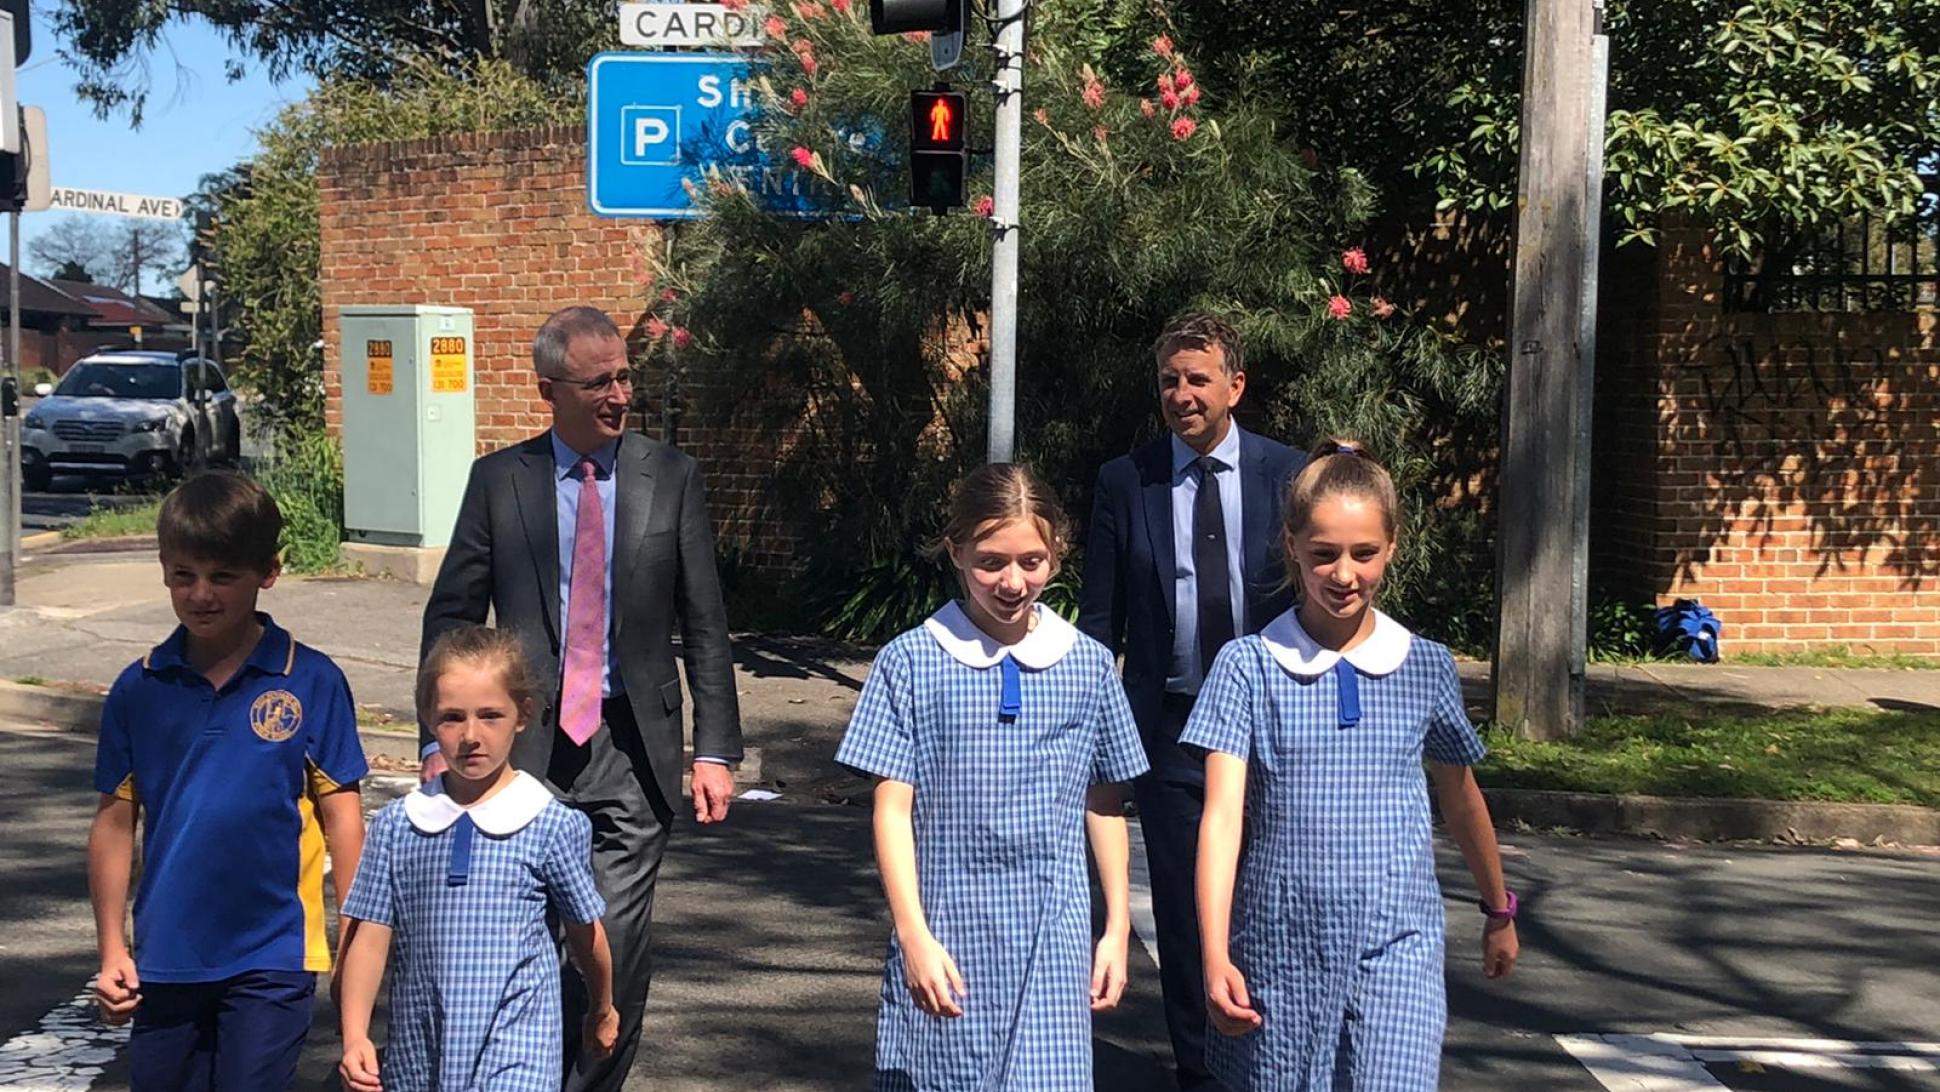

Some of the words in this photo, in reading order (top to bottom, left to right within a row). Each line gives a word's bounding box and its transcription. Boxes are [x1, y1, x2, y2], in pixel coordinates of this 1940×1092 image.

[635, 11, 758, 38] CARDI
[634, 118, 669, 156] P
[51, 189, 129, 213] ARDINAL
[137, 198, 172, 217] AVE
[432, 338, 464, 353] 2880
